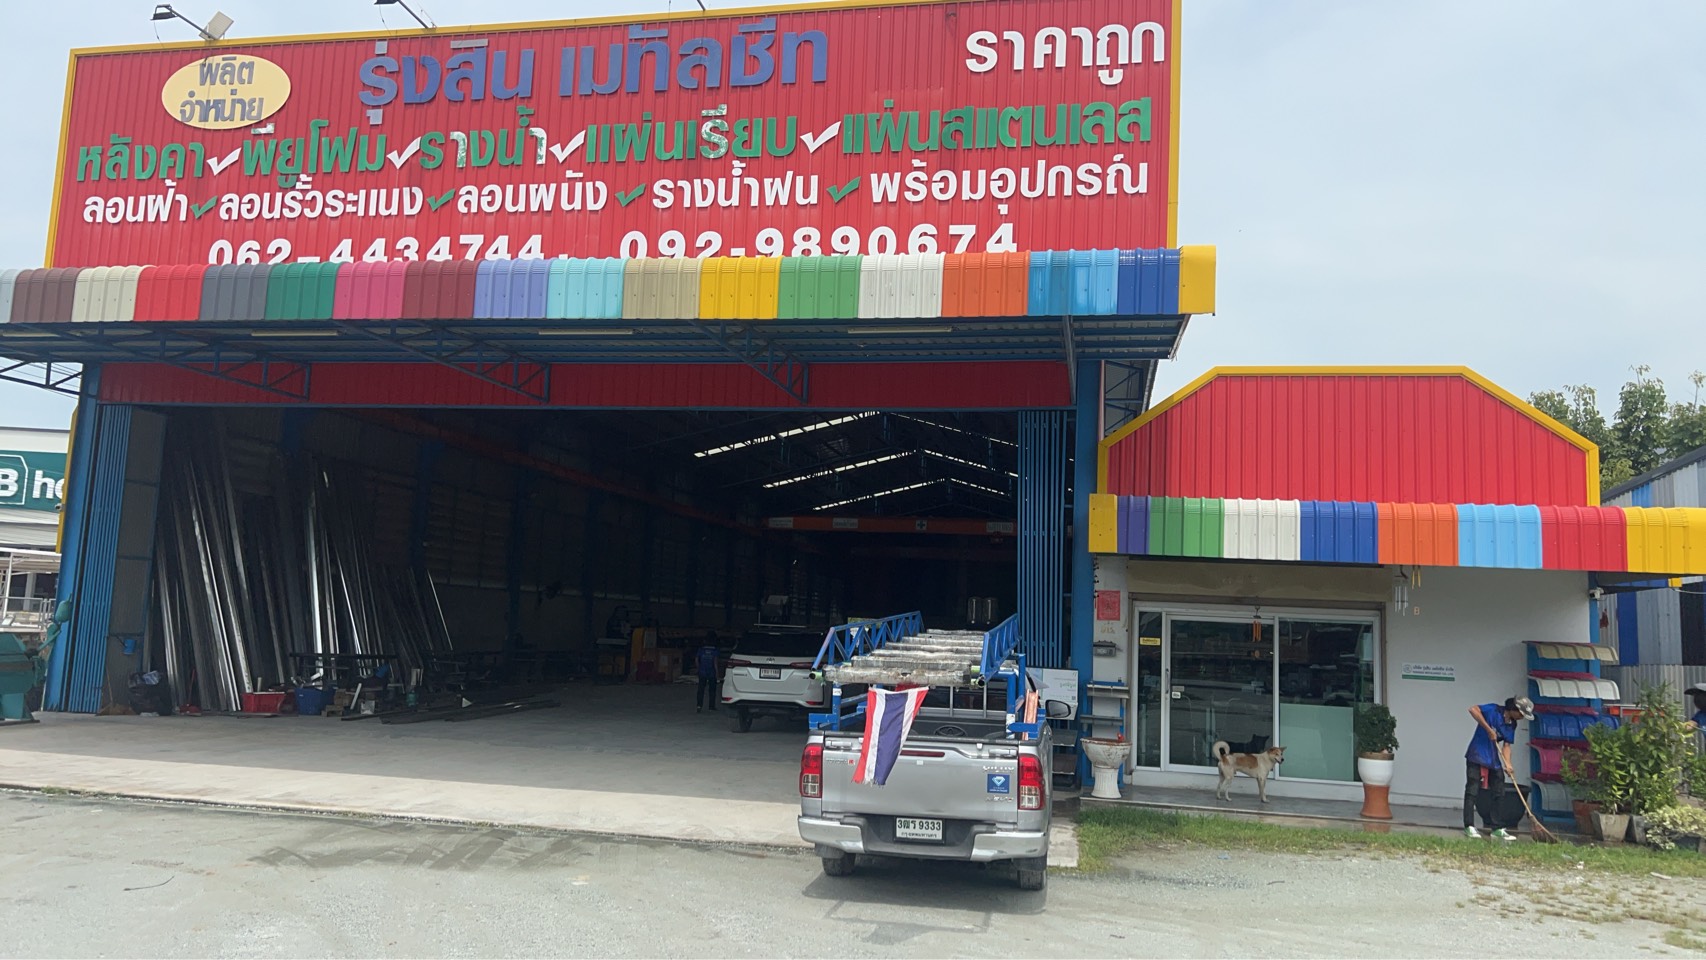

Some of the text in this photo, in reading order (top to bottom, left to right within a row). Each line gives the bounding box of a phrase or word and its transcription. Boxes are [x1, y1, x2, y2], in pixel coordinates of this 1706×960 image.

[199, 56, 255, 86] ผลิต
[358, 17, 828, 125] รุ่งสิน เมทัลชีท
[965, 21, 1165, 85] ราคาถูก
[179, 88, 264, 122] จำหน่าย
[76, 97, 1152, 188] หลังคา พียูโฟม รางน้ำ แผ่นเรียบ แผ่นสแตนเลส
[83, 153, 1148, 224] ลอนฝ้า ลอนรั้วระแนง ลอนผนัง รางน้ำฝน พร้อมอุปกรณ์
[619, 222, 1017, 259] 092-9890674
[918, 820, 941, 831] 9333
